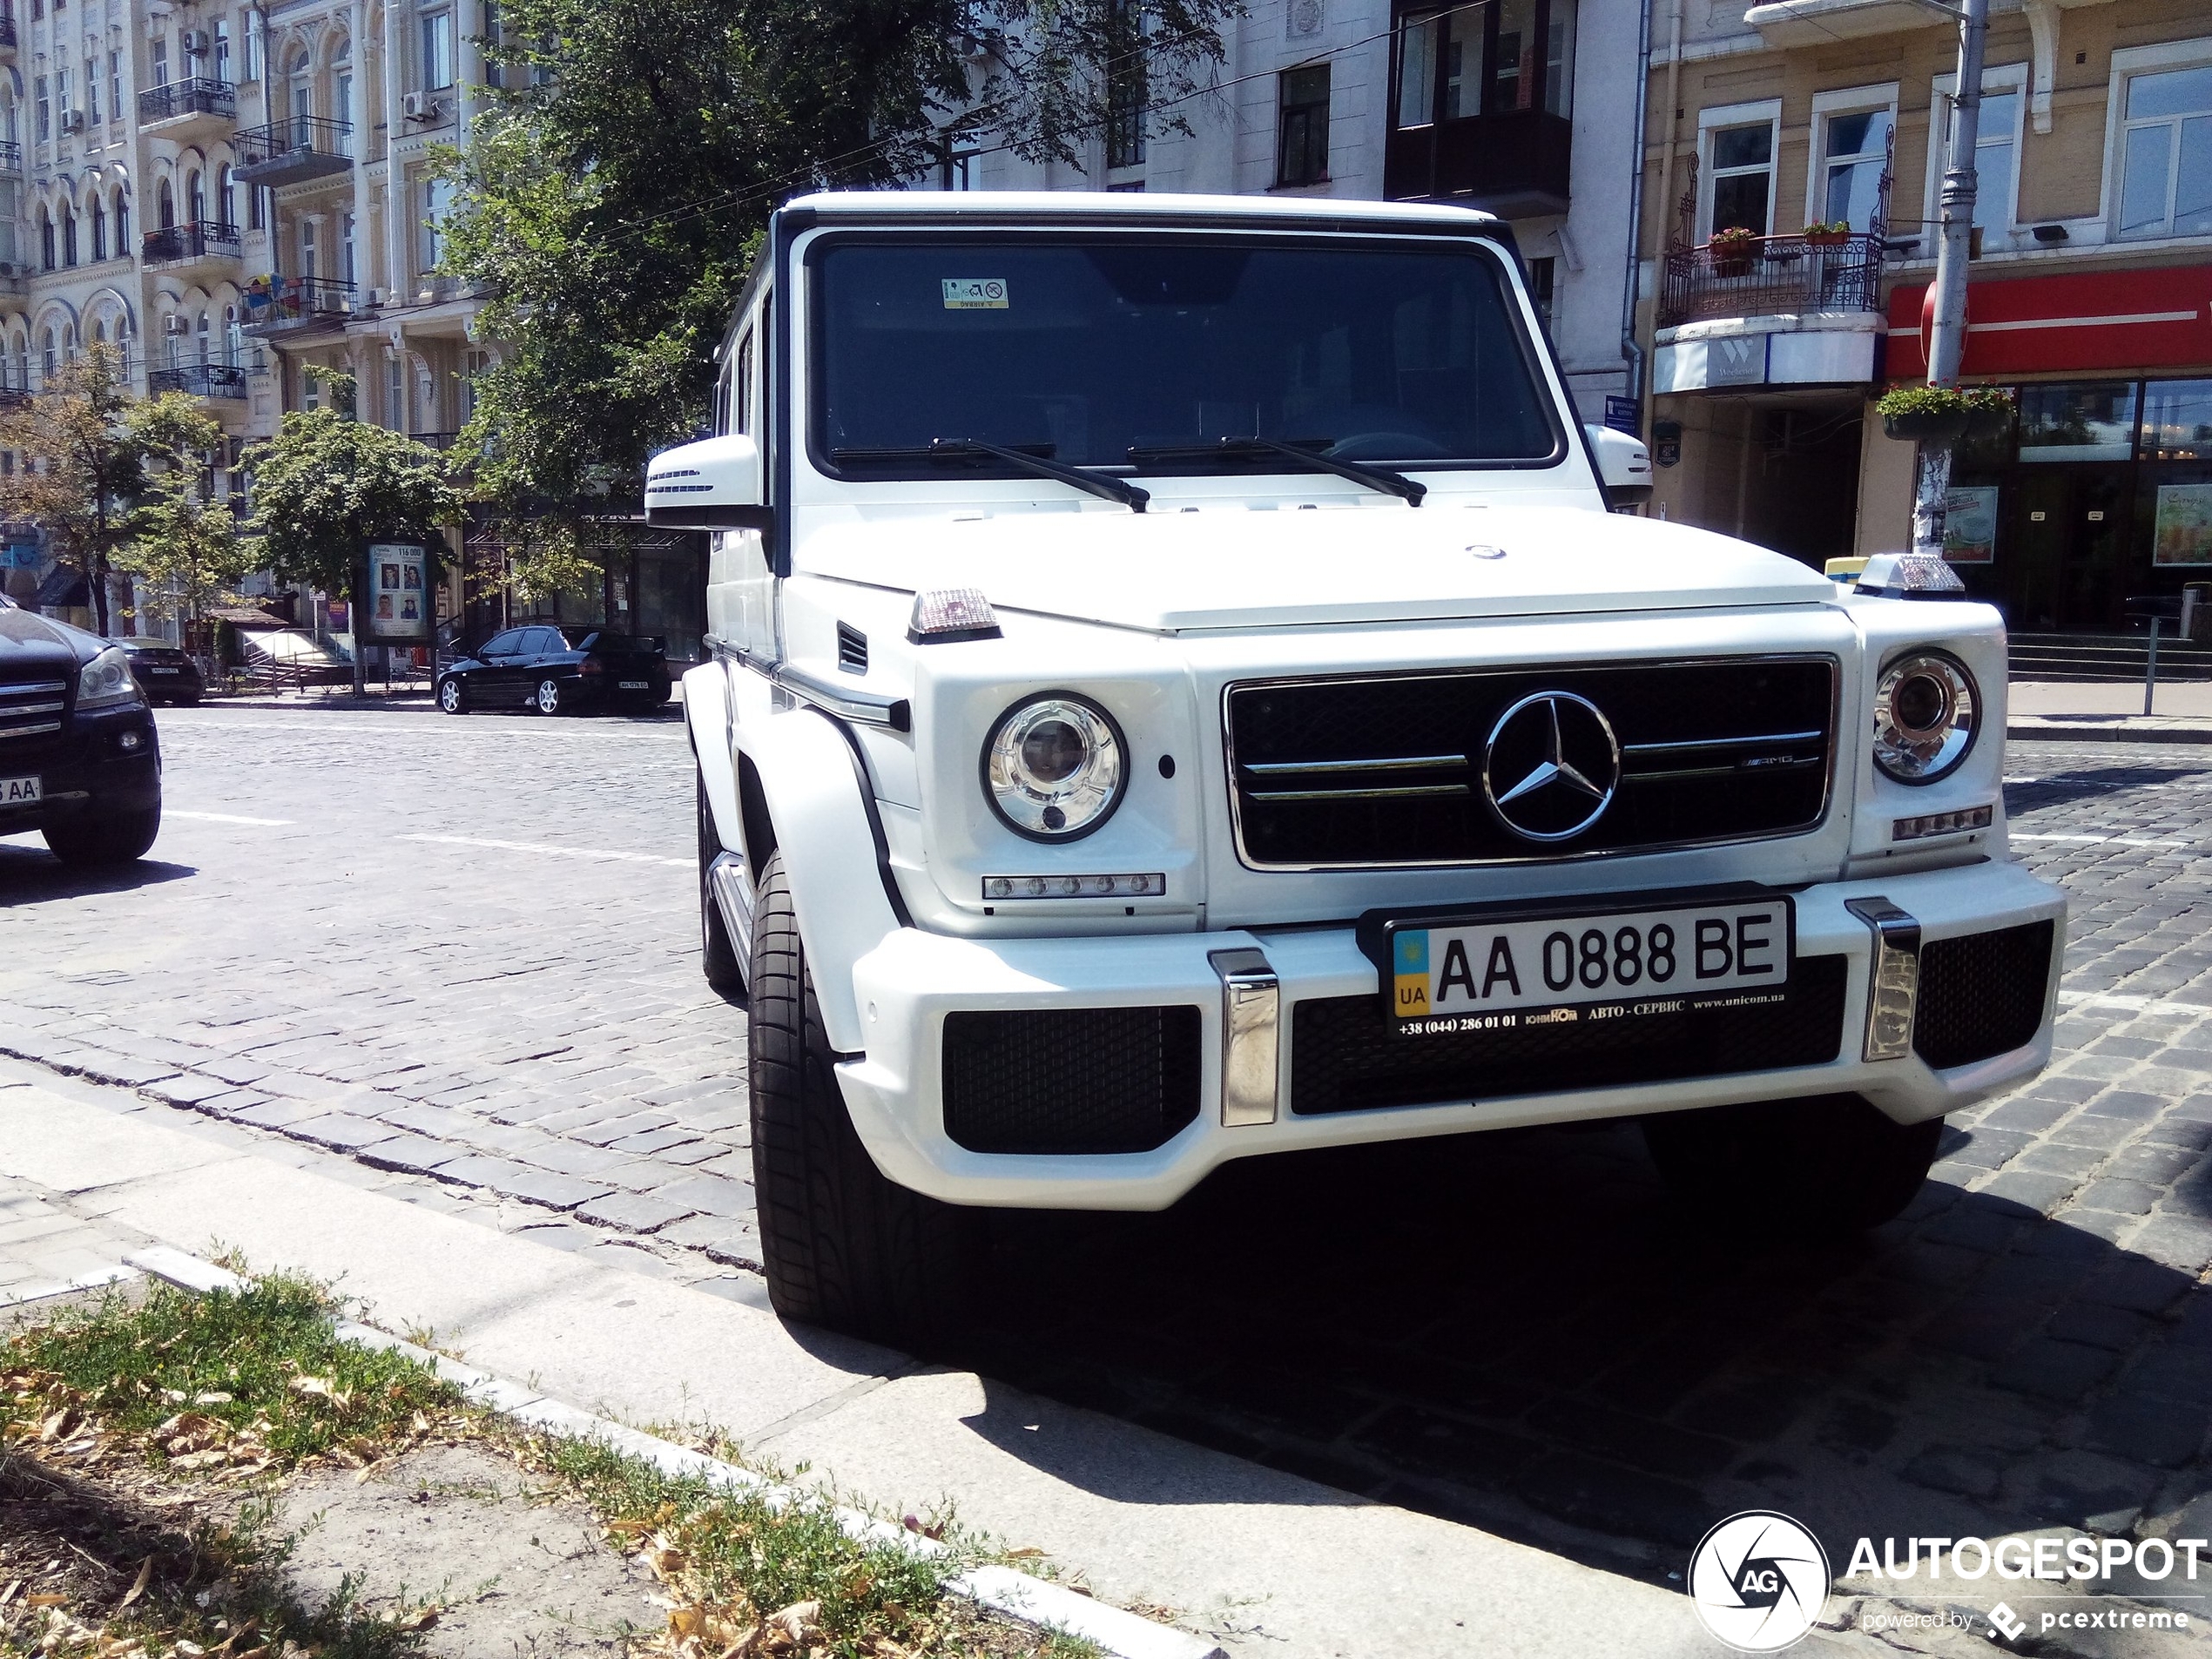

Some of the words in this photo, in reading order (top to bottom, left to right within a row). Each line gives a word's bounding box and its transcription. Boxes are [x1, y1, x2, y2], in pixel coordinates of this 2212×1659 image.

[9, 780, 36, 800] AA
[1436, 935, 1521, 1002] AA
[1542, 923, 1676, 992] 0888
[1695, 914, 1774, 980] BE
[1400, 987, 1426, 1005] UA
[1399, 1022, 1423, 1035] +38
[1425, 1019, 1458, 1035] (044)
[1460, 1017, 1482, 1031] 286
[1484, 1016, 1499, 1028] 01
[1501, 1015, 1517, 1027] 01
[1588, 1006, 1624, 1021] АВТО
[1633, 1000, 1686, 1016] СЕРВИС
[1693, 994, 1785, 1009] www.unicom.ua
